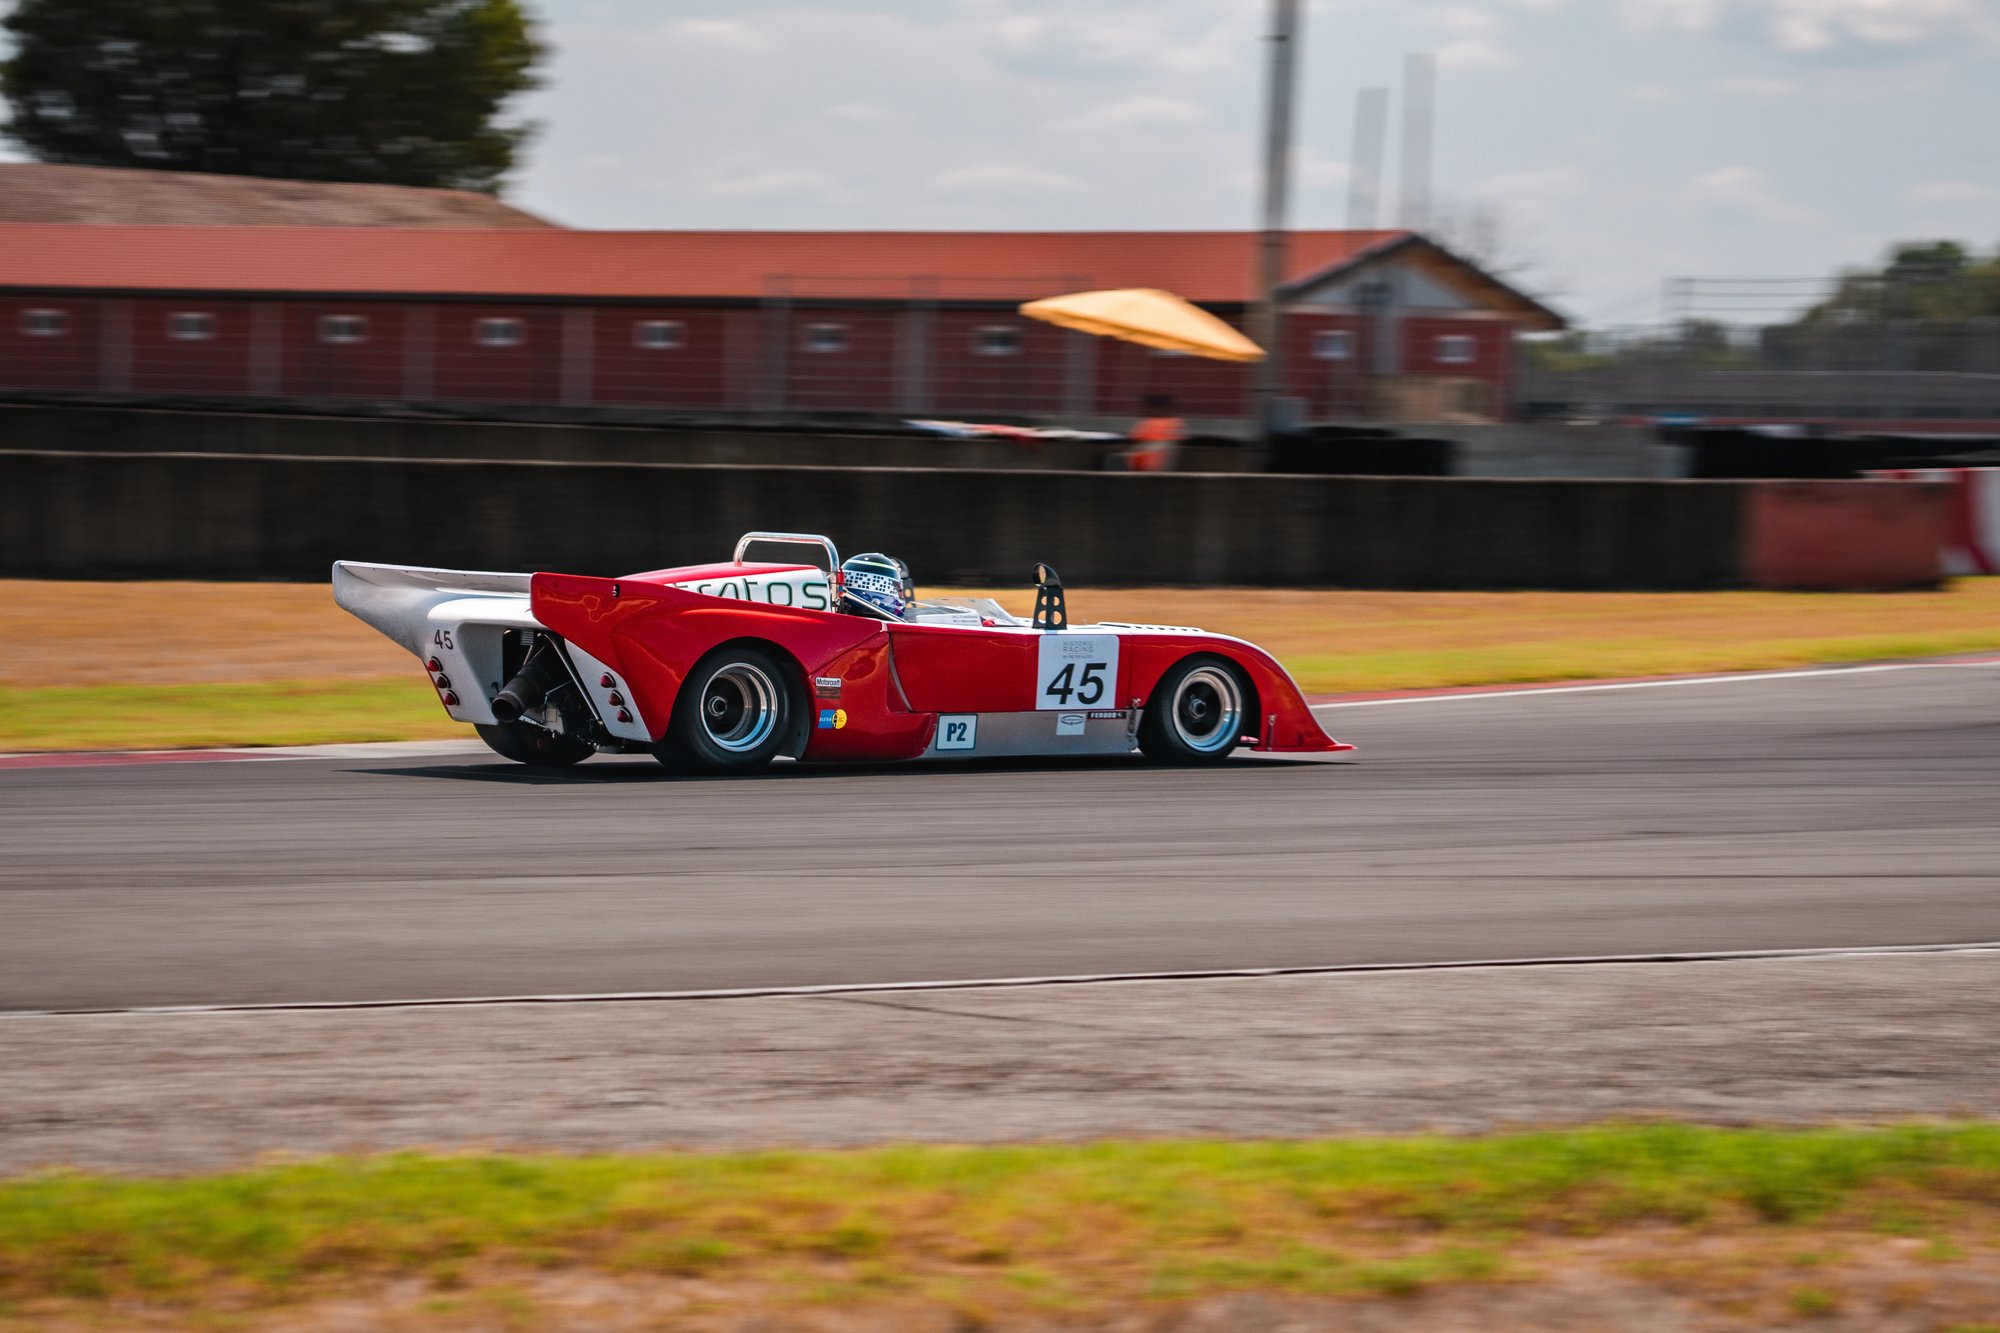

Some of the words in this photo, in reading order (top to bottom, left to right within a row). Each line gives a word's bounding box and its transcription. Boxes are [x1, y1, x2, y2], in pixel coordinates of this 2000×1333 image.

[434, 629, 453, 650] 45
[816, 678, 840, 686] Motorcraft
[1046, 662, 1107, 705] 45
[946, 722, 967, 742] P2
